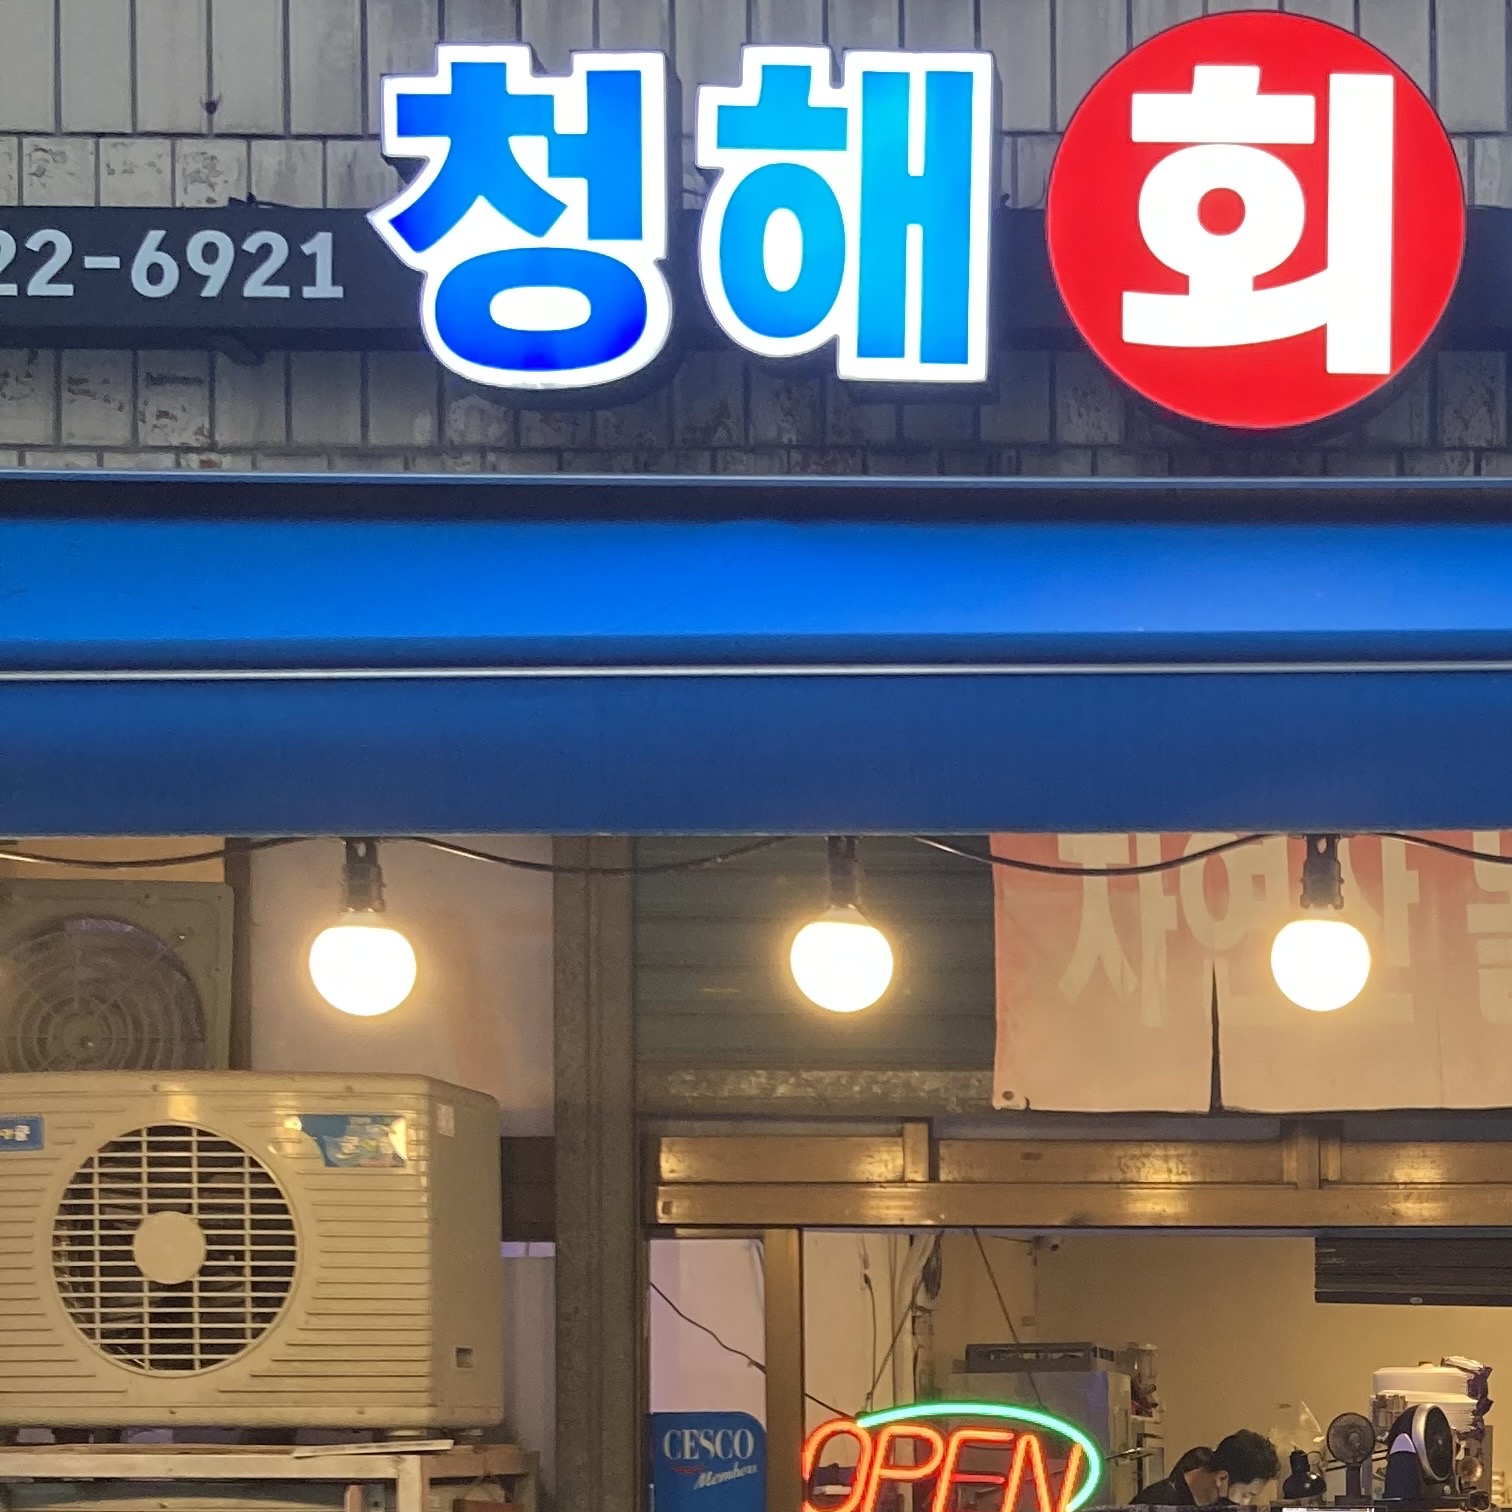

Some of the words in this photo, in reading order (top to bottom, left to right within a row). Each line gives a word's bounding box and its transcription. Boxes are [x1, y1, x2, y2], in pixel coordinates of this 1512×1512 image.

[372, 44, 992, 389] 청해
[1121, 64, 1396, 375] 회
[663, 1428, 755, 1461] CESCO
